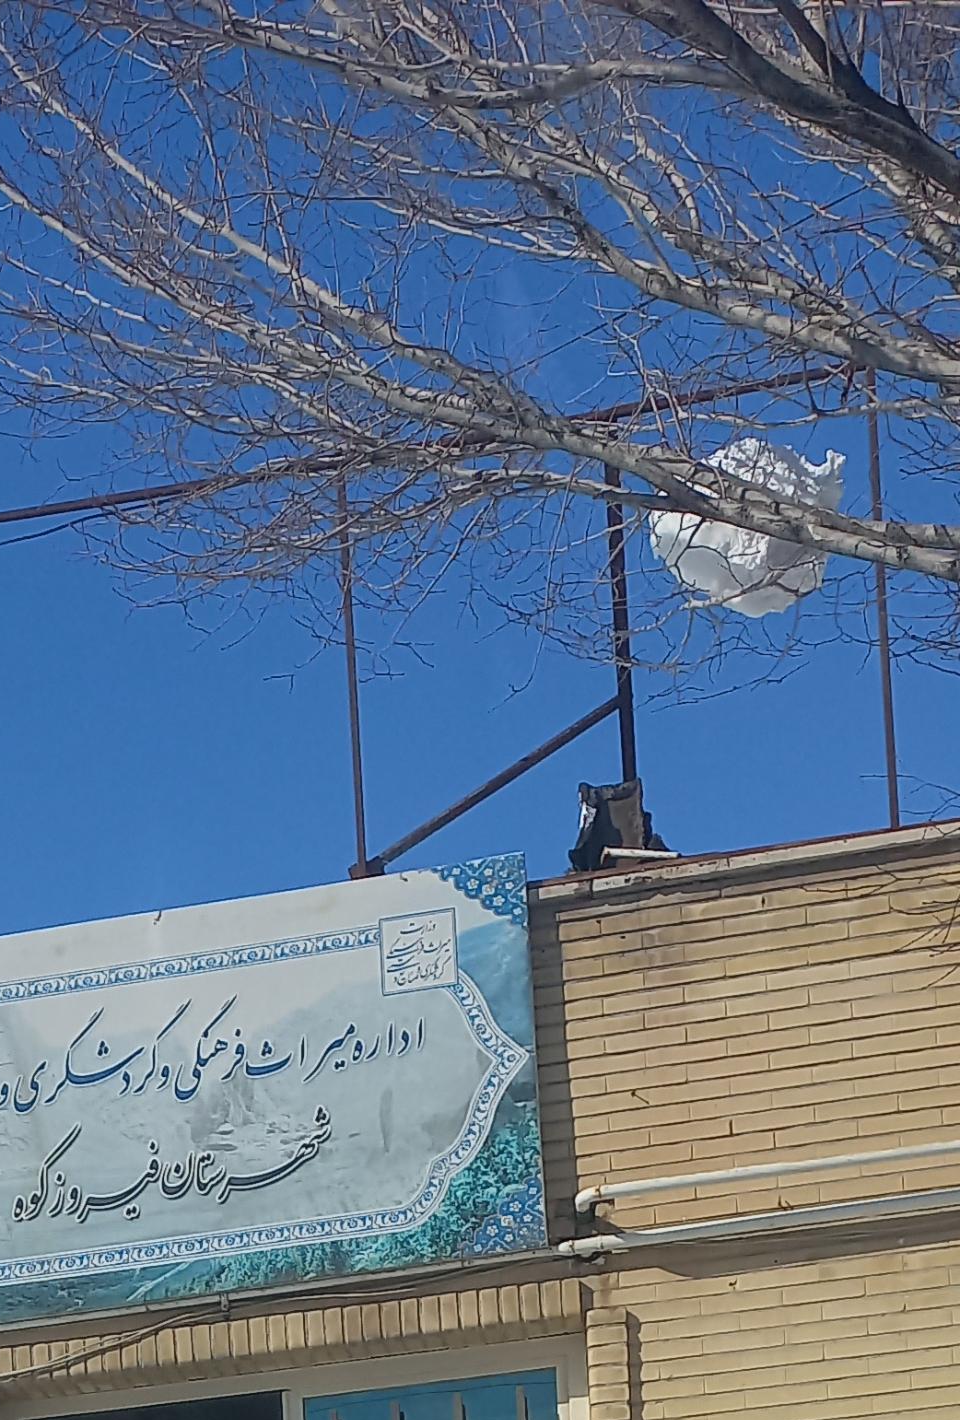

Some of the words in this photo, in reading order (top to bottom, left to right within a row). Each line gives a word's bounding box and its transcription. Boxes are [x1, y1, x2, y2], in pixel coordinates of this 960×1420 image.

[13, 998, 193, 1113] گردشگری
[174, 994, 246, 1101] فرهنگی
[245, 1022, 357, 1083] میراث
[351, 1016, 424, 1063] اداره
[160, 1105, 331, 1203] شهرستان
